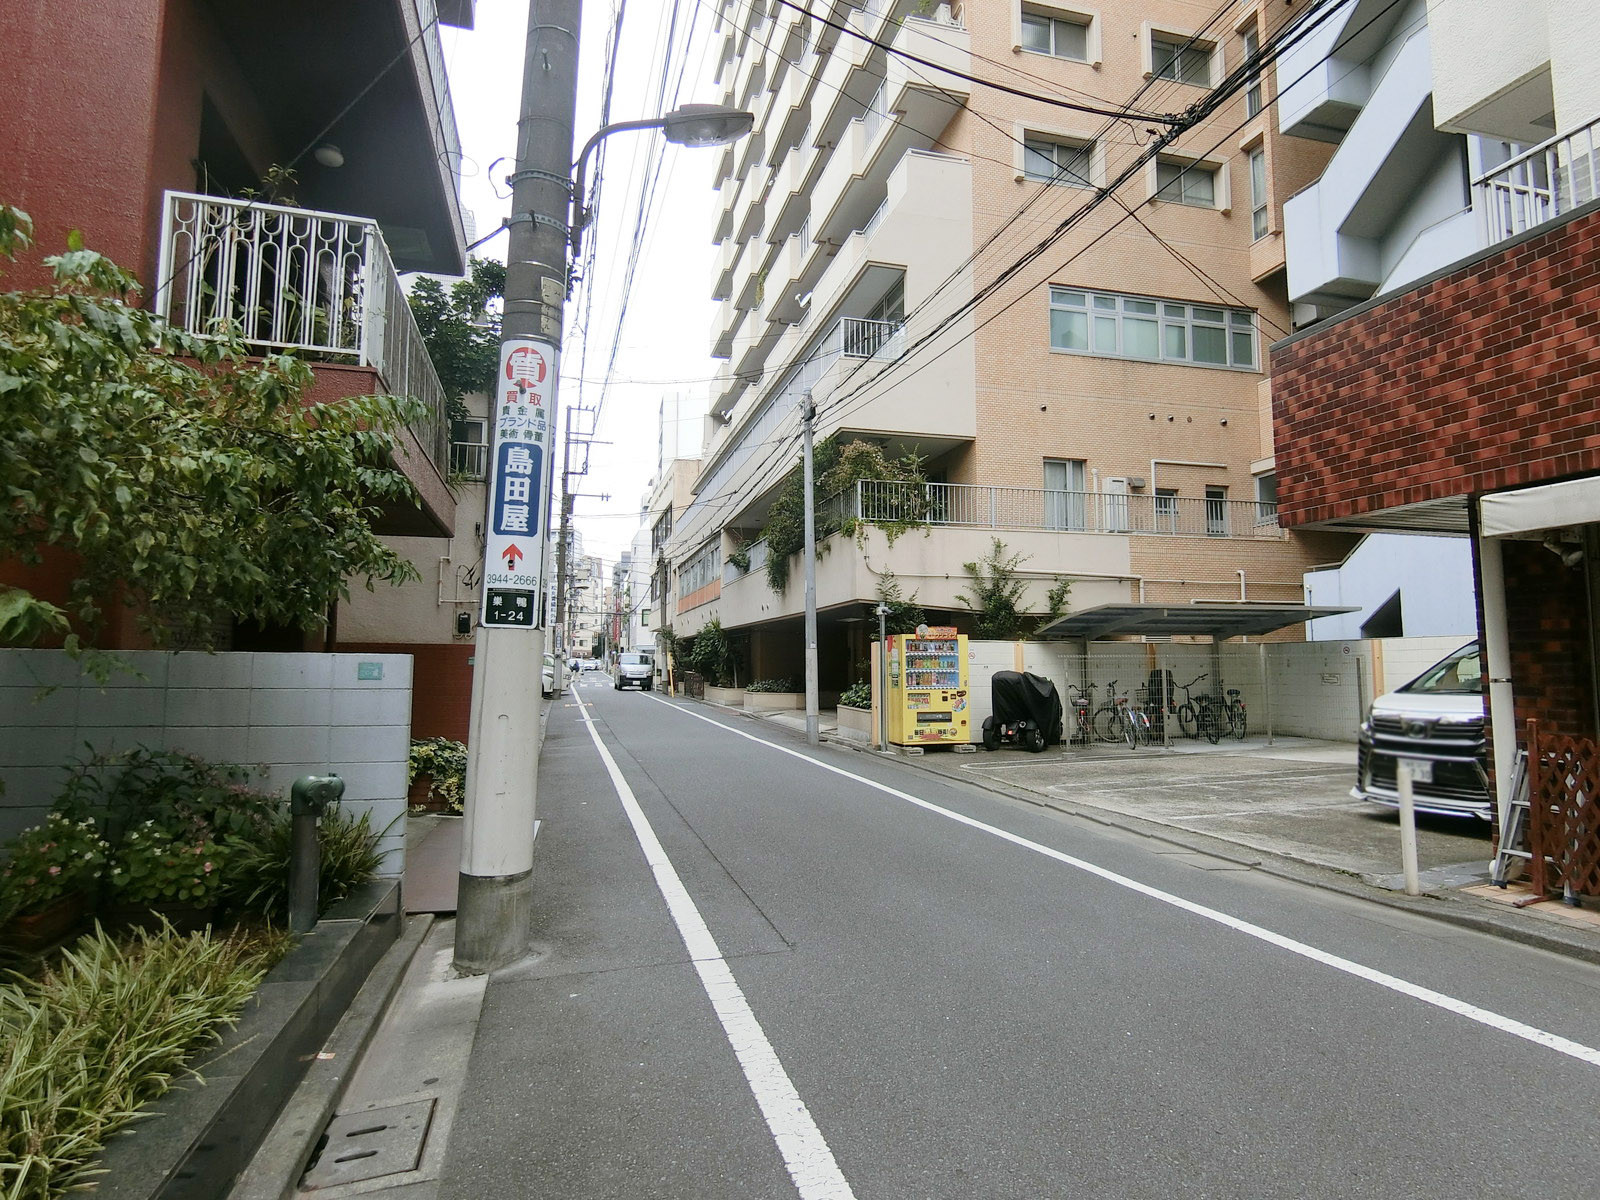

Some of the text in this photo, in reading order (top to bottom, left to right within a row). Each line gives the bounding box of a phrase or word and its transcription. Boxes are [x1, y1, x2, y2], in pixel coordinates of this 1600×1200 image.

[509, 351, 543, 386] 質
[506, 390, 542, 407] 買取
[502, 405, 545, 419] 貴金属
[499, 417, 547, 431] ブランド品
[500, 446, 534, 533] 島田屋
[486, 573, 538, 587] 3944-2666
[492, 595, 527, 608] 巣鴨
[494, 610, 524, 621] 1-24
